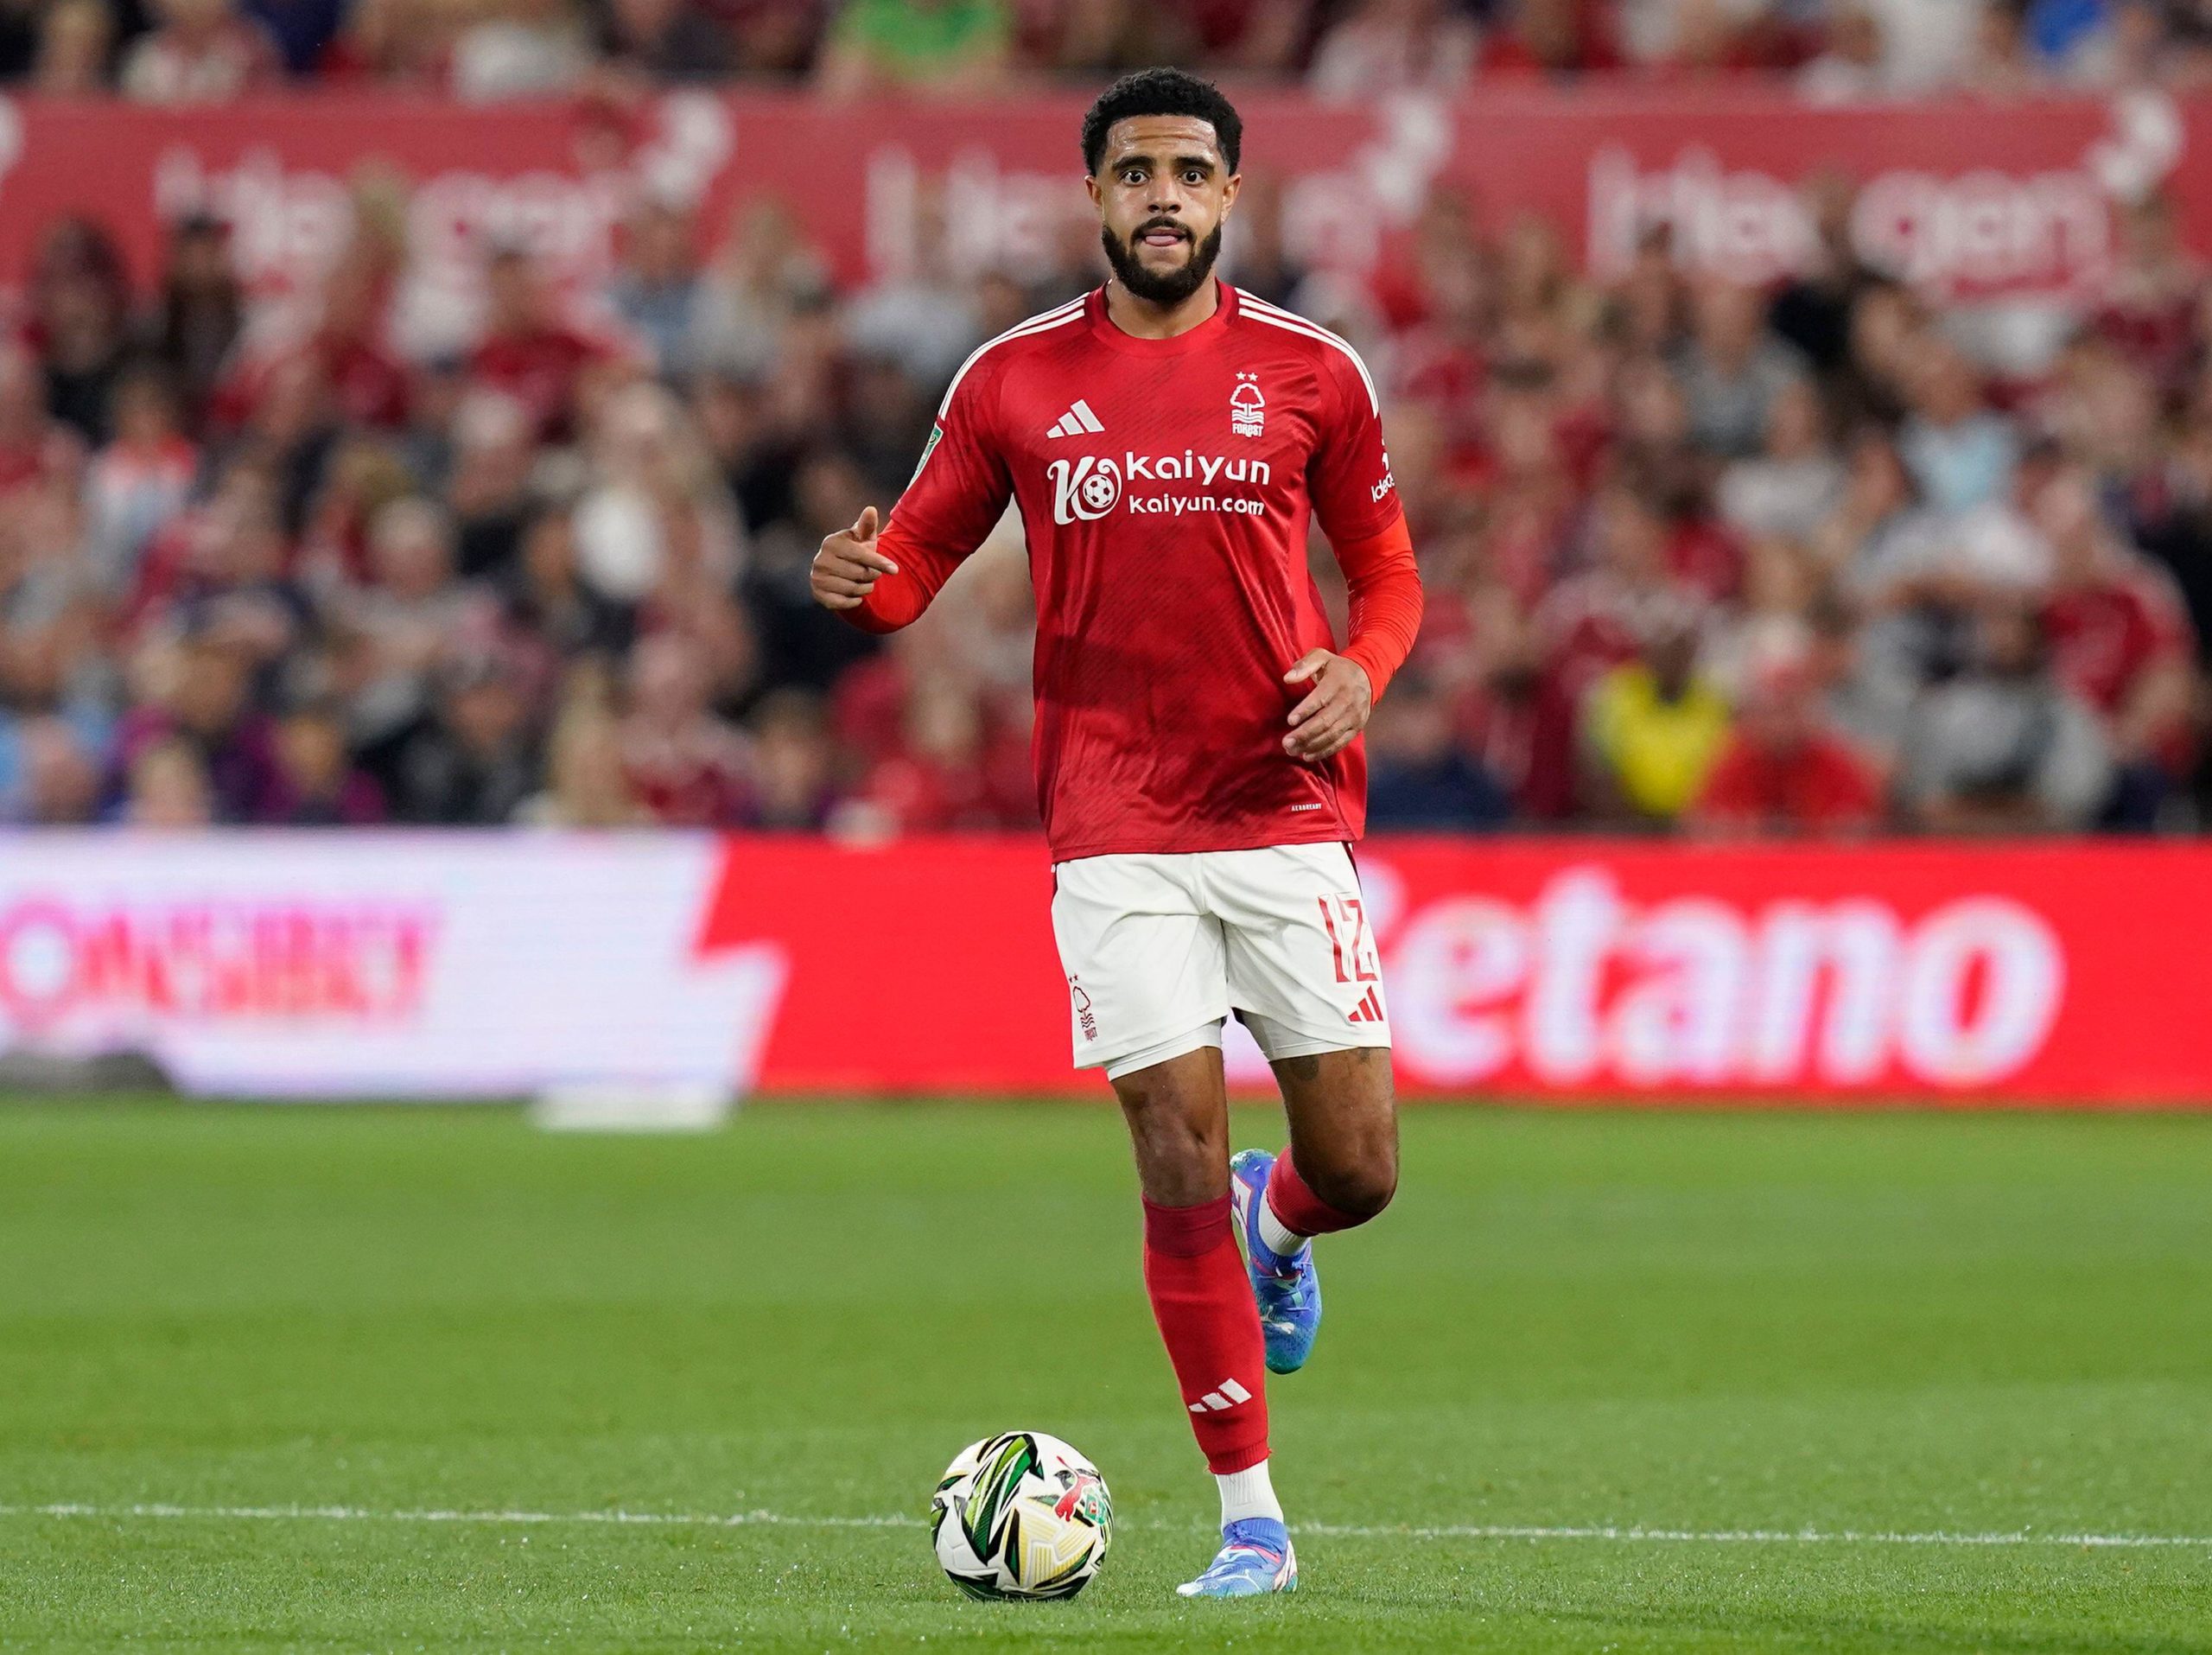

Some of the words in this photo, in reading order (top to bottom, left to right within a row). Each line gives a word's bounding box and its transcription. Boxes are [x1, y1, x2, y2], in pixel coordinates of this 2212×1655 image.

[1232, 423, 1264, 437] FOREST
[1318, 893, 1378, 983] 12
[1363, 864, 2066, 1089] etano
